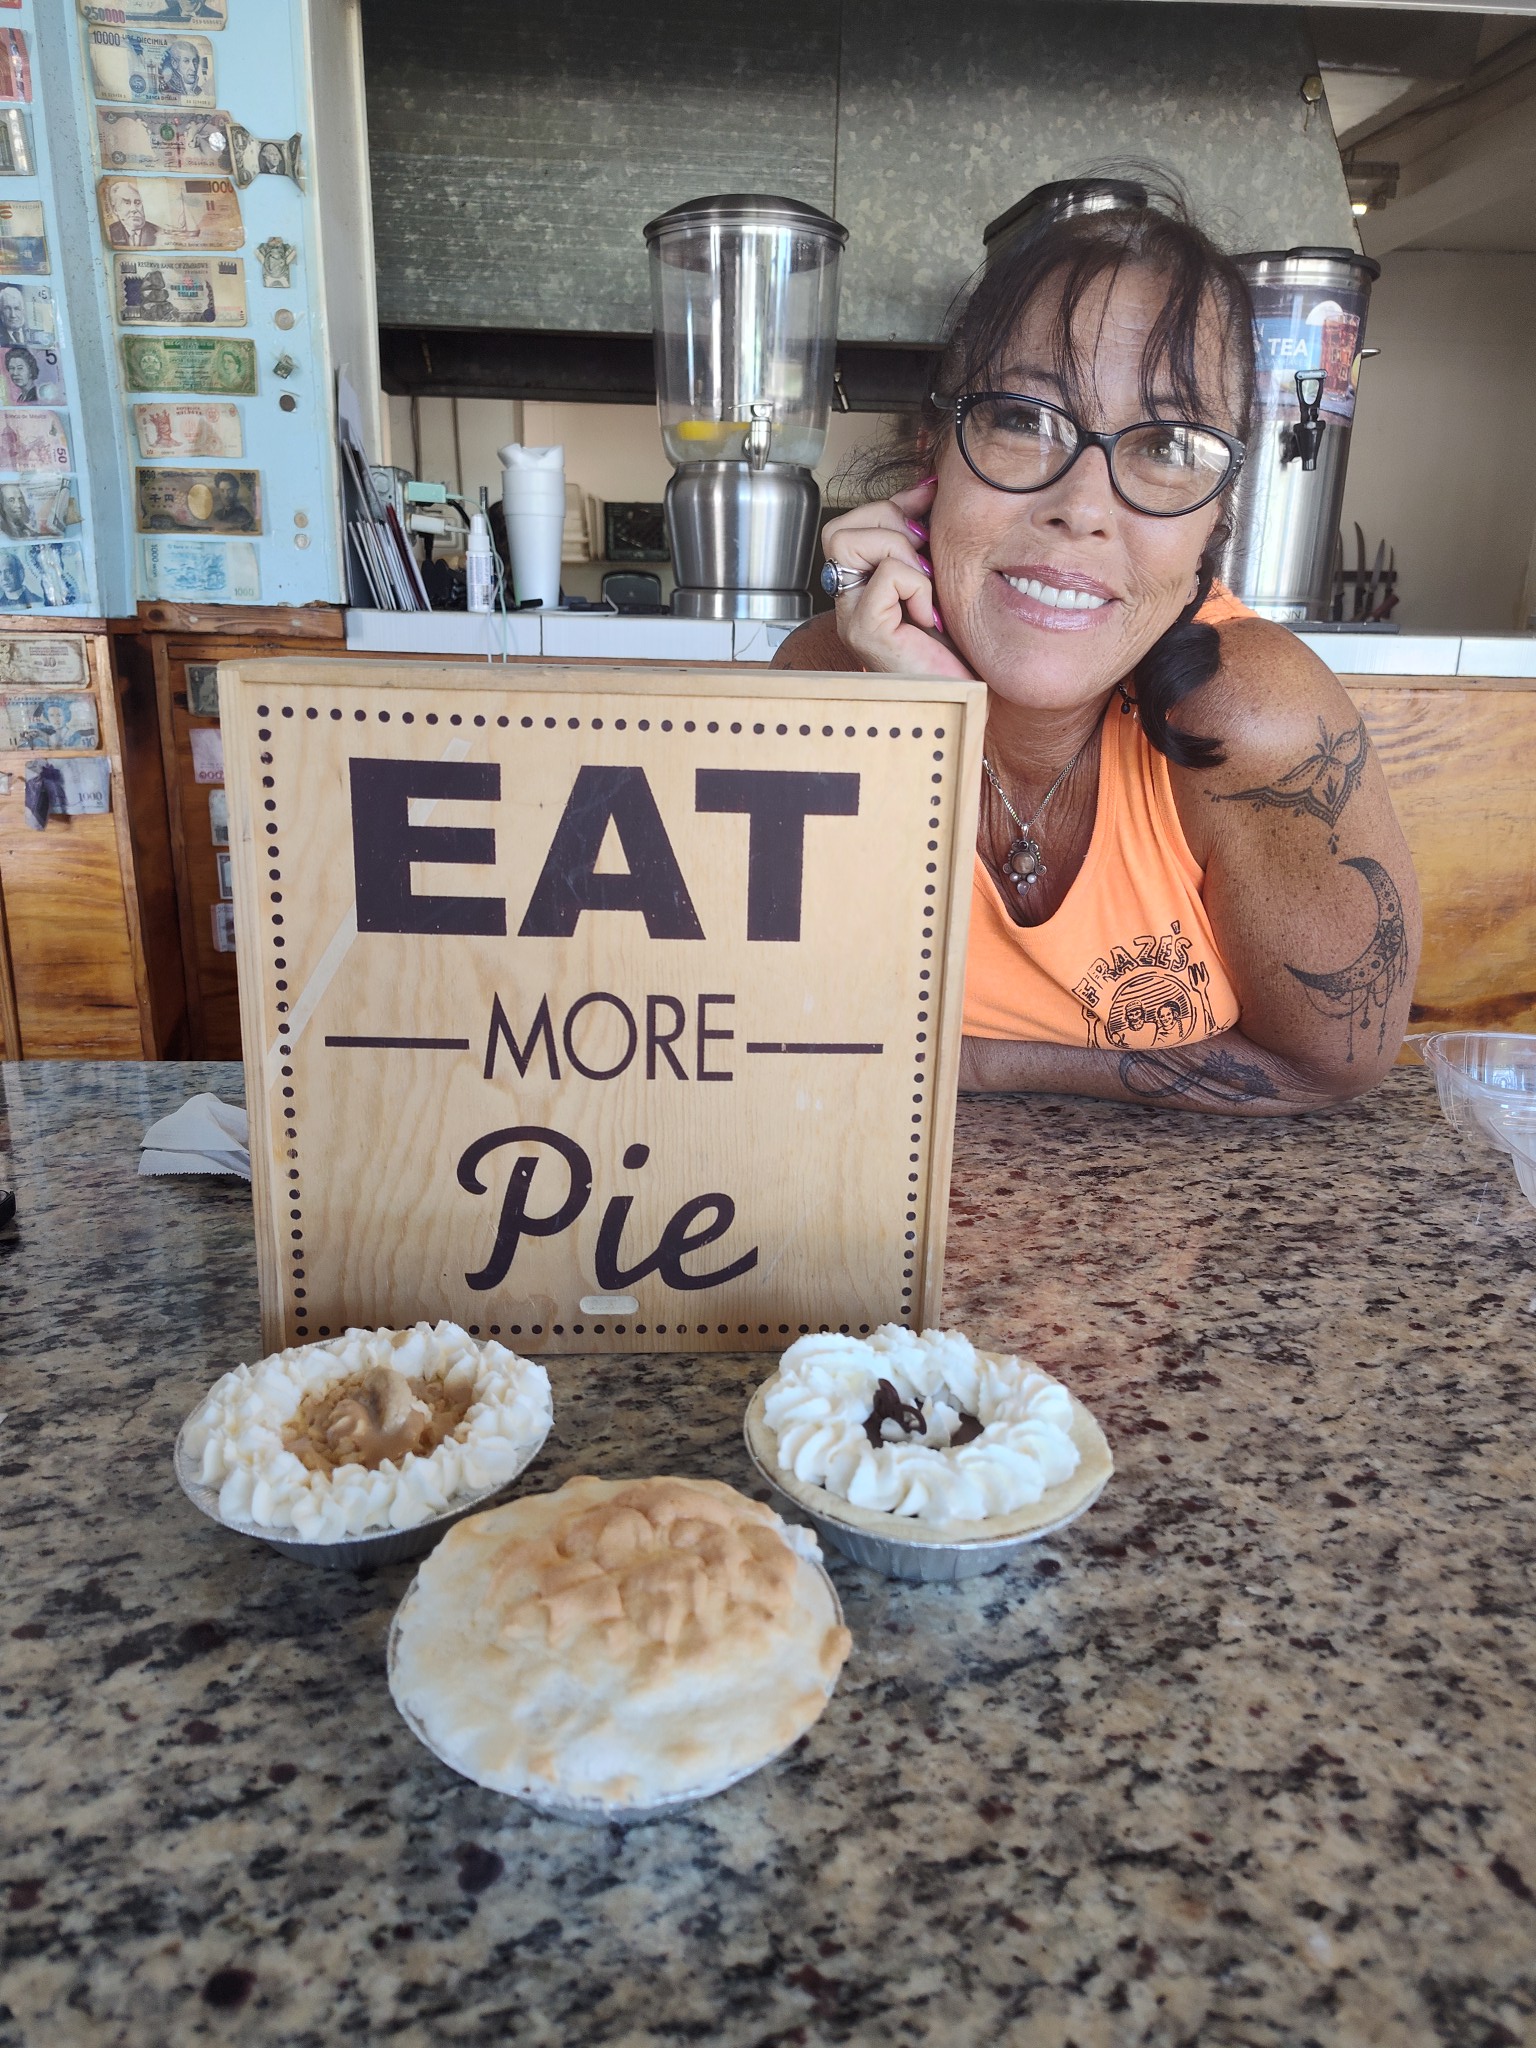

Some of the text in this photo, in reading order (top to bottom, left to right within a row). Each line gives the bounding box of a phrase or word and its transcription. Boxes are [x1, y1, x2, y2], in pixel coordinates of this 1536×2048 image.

[93, 31, 121, 46] 10000
[1268, 338, 1308, 356] TEA
[45, 349, 58, 366] 5
[57, 447, 68, 464] 50
[151, 543, 159, 563] 1000
[349, 757, 860, 941] EAT
[484, 992, 735, 1081] MORE
[457, 1126, 758, 1291] Pie
